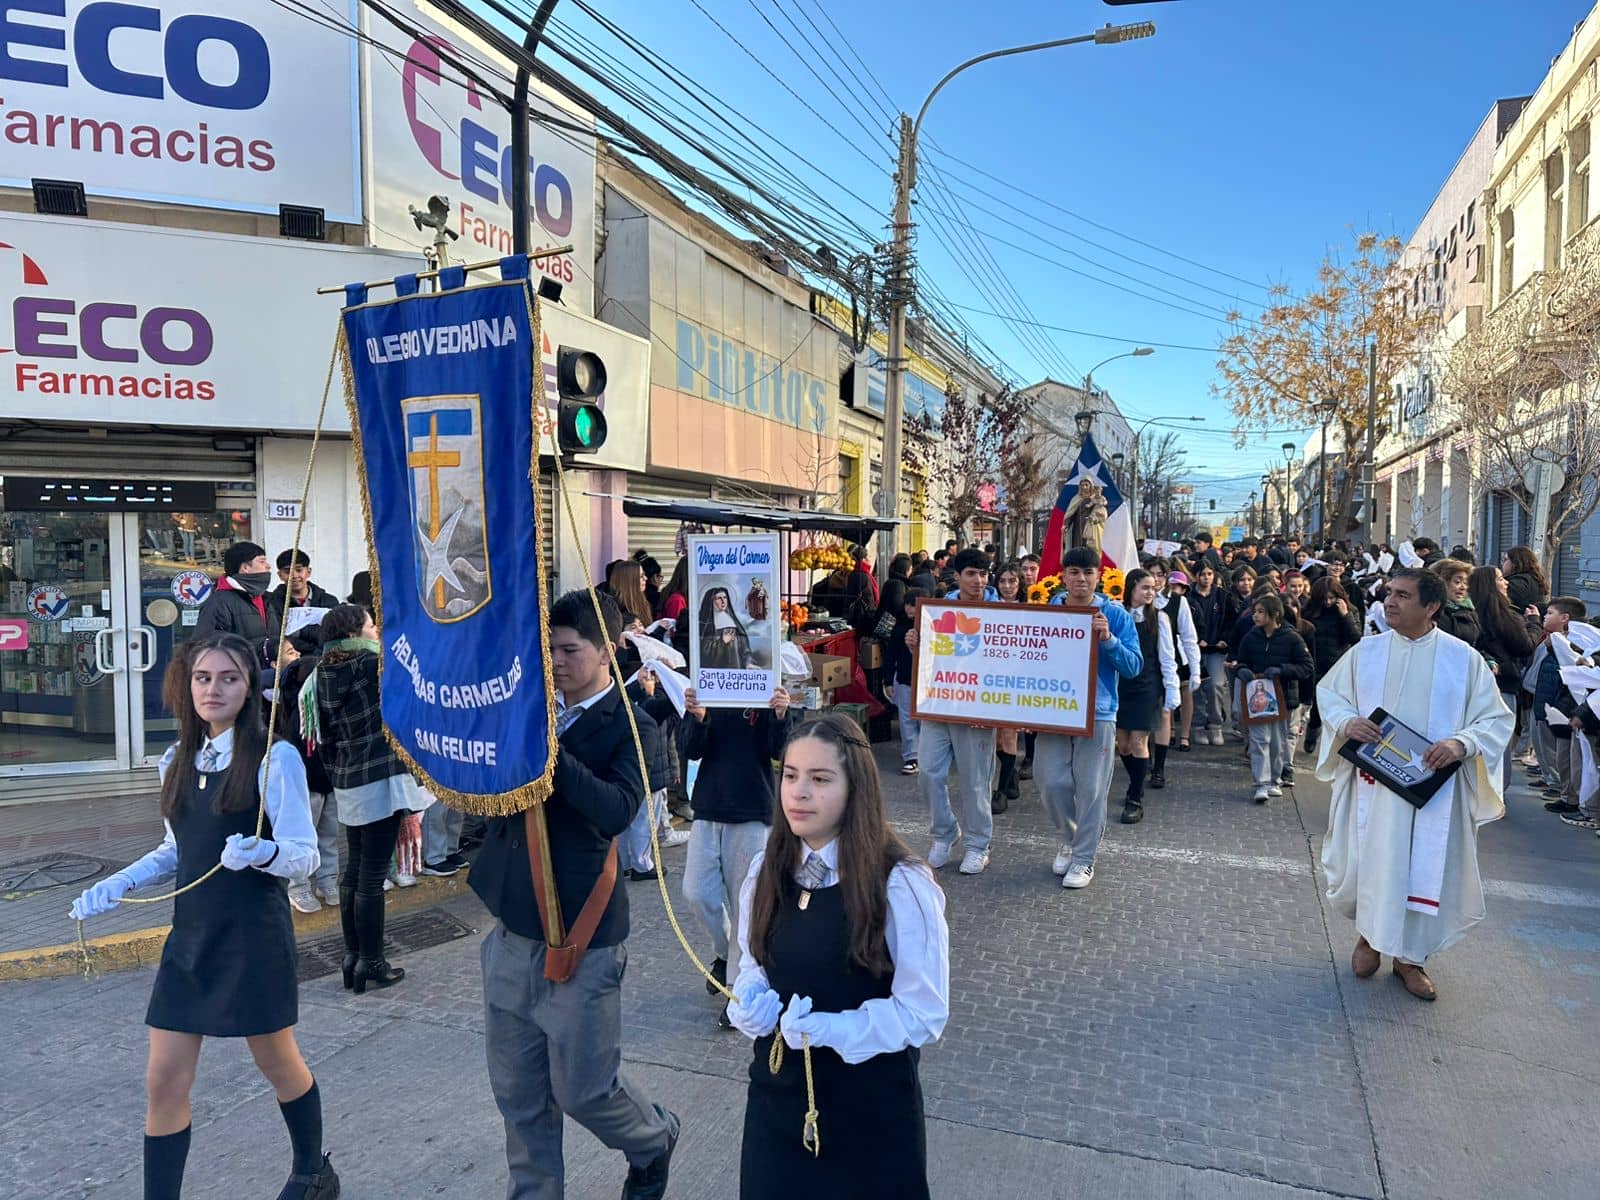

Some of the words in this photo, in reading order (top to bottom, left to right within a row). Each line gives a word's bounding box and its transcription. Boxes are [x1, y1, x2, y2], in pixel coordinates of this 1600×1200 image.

[0, 0, 271, 110] ECO
[0, 98, 276, 172] armacias
[460, 202, 574, 283] Farmcias
[13, 296, 214, 366] ECO
[16, 363, 216, 401] Farmacias
[276, 504, 296, 517] 911
[697, 544, 724, 572] Virgen
[725, 547, 737, 564] del
[739, 544, 771, 566] Carmen
[983, 623, 1085, 640] BICENTENARIO
[983, 635, 1048, 649] VEDRUNA
[983, 649, 1009, 659] 1826
[1019, 650, 1048, 661] 2026
[699, 678, 714, 689] De
[716, 678, 767, 691] Vedruna
[700, 670, 725, 680] Santa
[727, 670, 767, 683] Joaquina
[934, 670, 978, 685] AMOR
[983, 674, 1076, 696] GENEROSO,
[926, 686, 976, 702] MISIÓN
[980, 691, 1011, 705] QUE
[1016, 694, 1079, 711] INSPIRA
[441, 735, 497, 766] FELIPE
